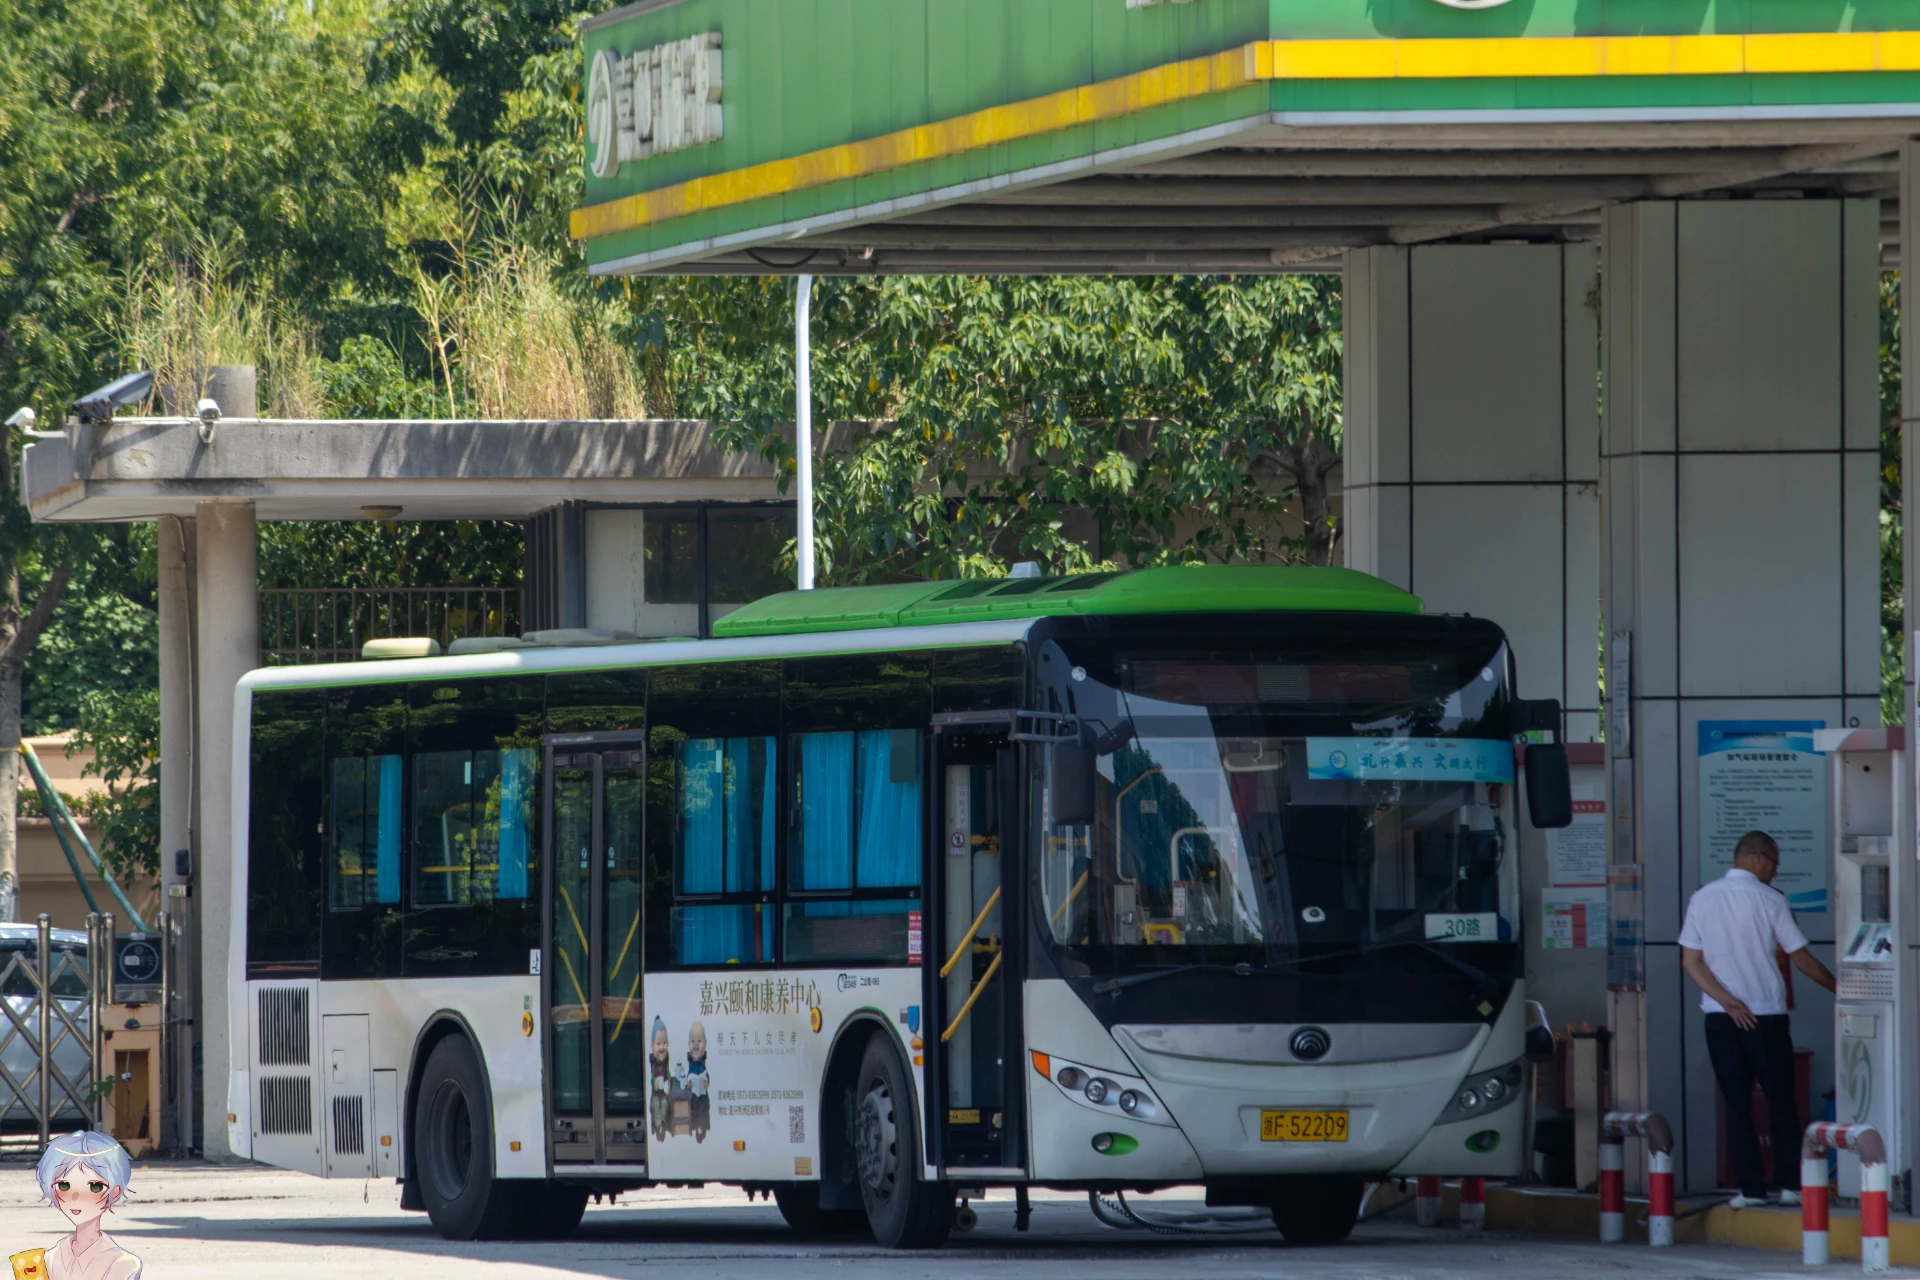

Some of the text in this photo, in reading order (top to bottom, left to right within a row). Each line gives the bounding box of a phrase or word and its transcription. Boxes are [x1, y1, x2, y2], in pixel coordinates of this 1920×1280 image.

[1444, 918, 1481, 937] 30路
[699, 978, 822, 1016] 嘉兴颐和康养中心
[717, 1031, 797, 1046] 帮天下儿女尽孝
